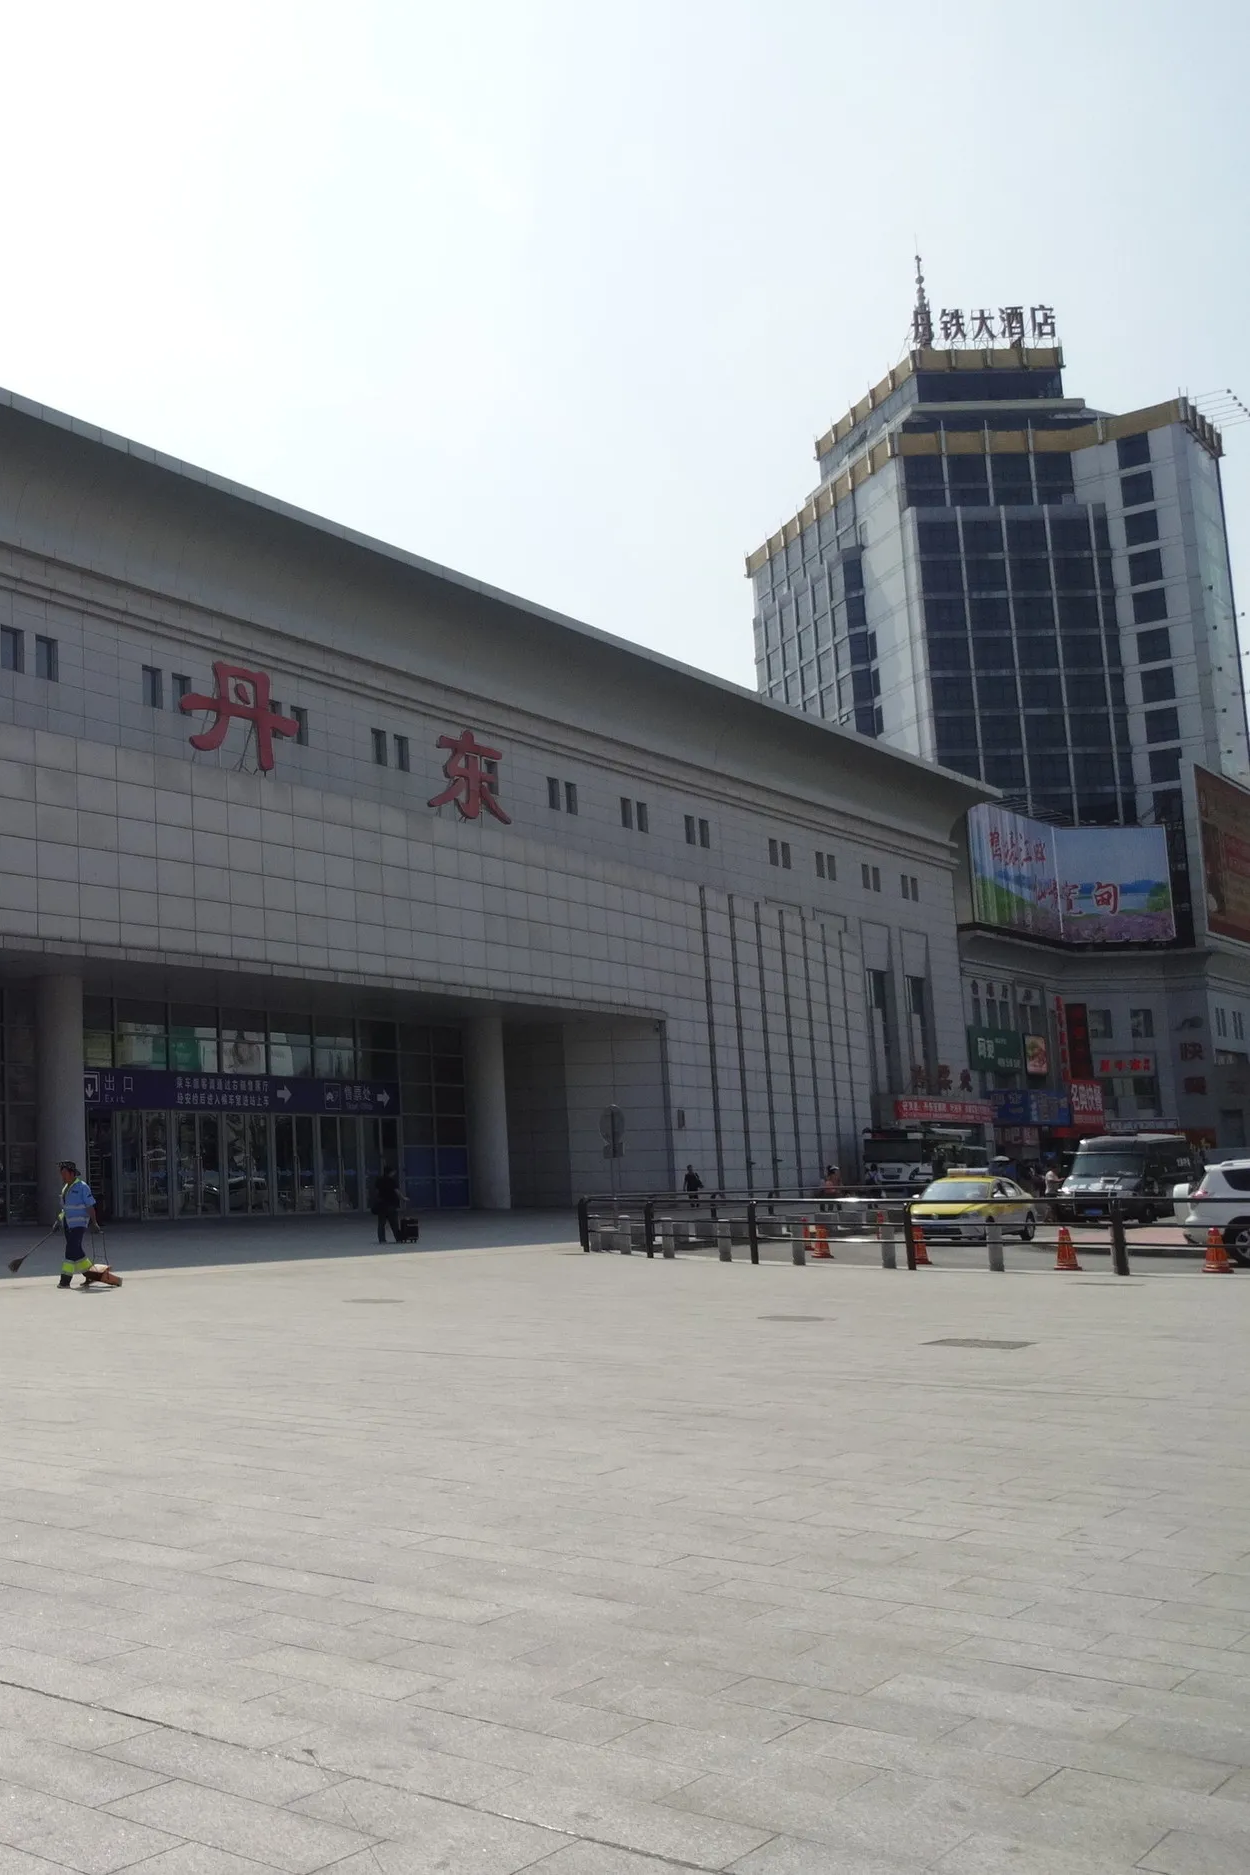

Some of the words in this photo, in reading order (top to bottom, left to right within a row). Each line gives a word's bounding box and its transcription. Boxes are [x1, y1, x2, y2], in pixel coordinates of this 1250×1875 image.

[912, 304, 1056, 342] 丹铁大酒店
[178, 660, 512, 826] 丹东
[103, 1075, 134, 1092] 出口
[104, 1093, 126, 1104] Exit
[344, 1084, 371, 1102] 售票处
